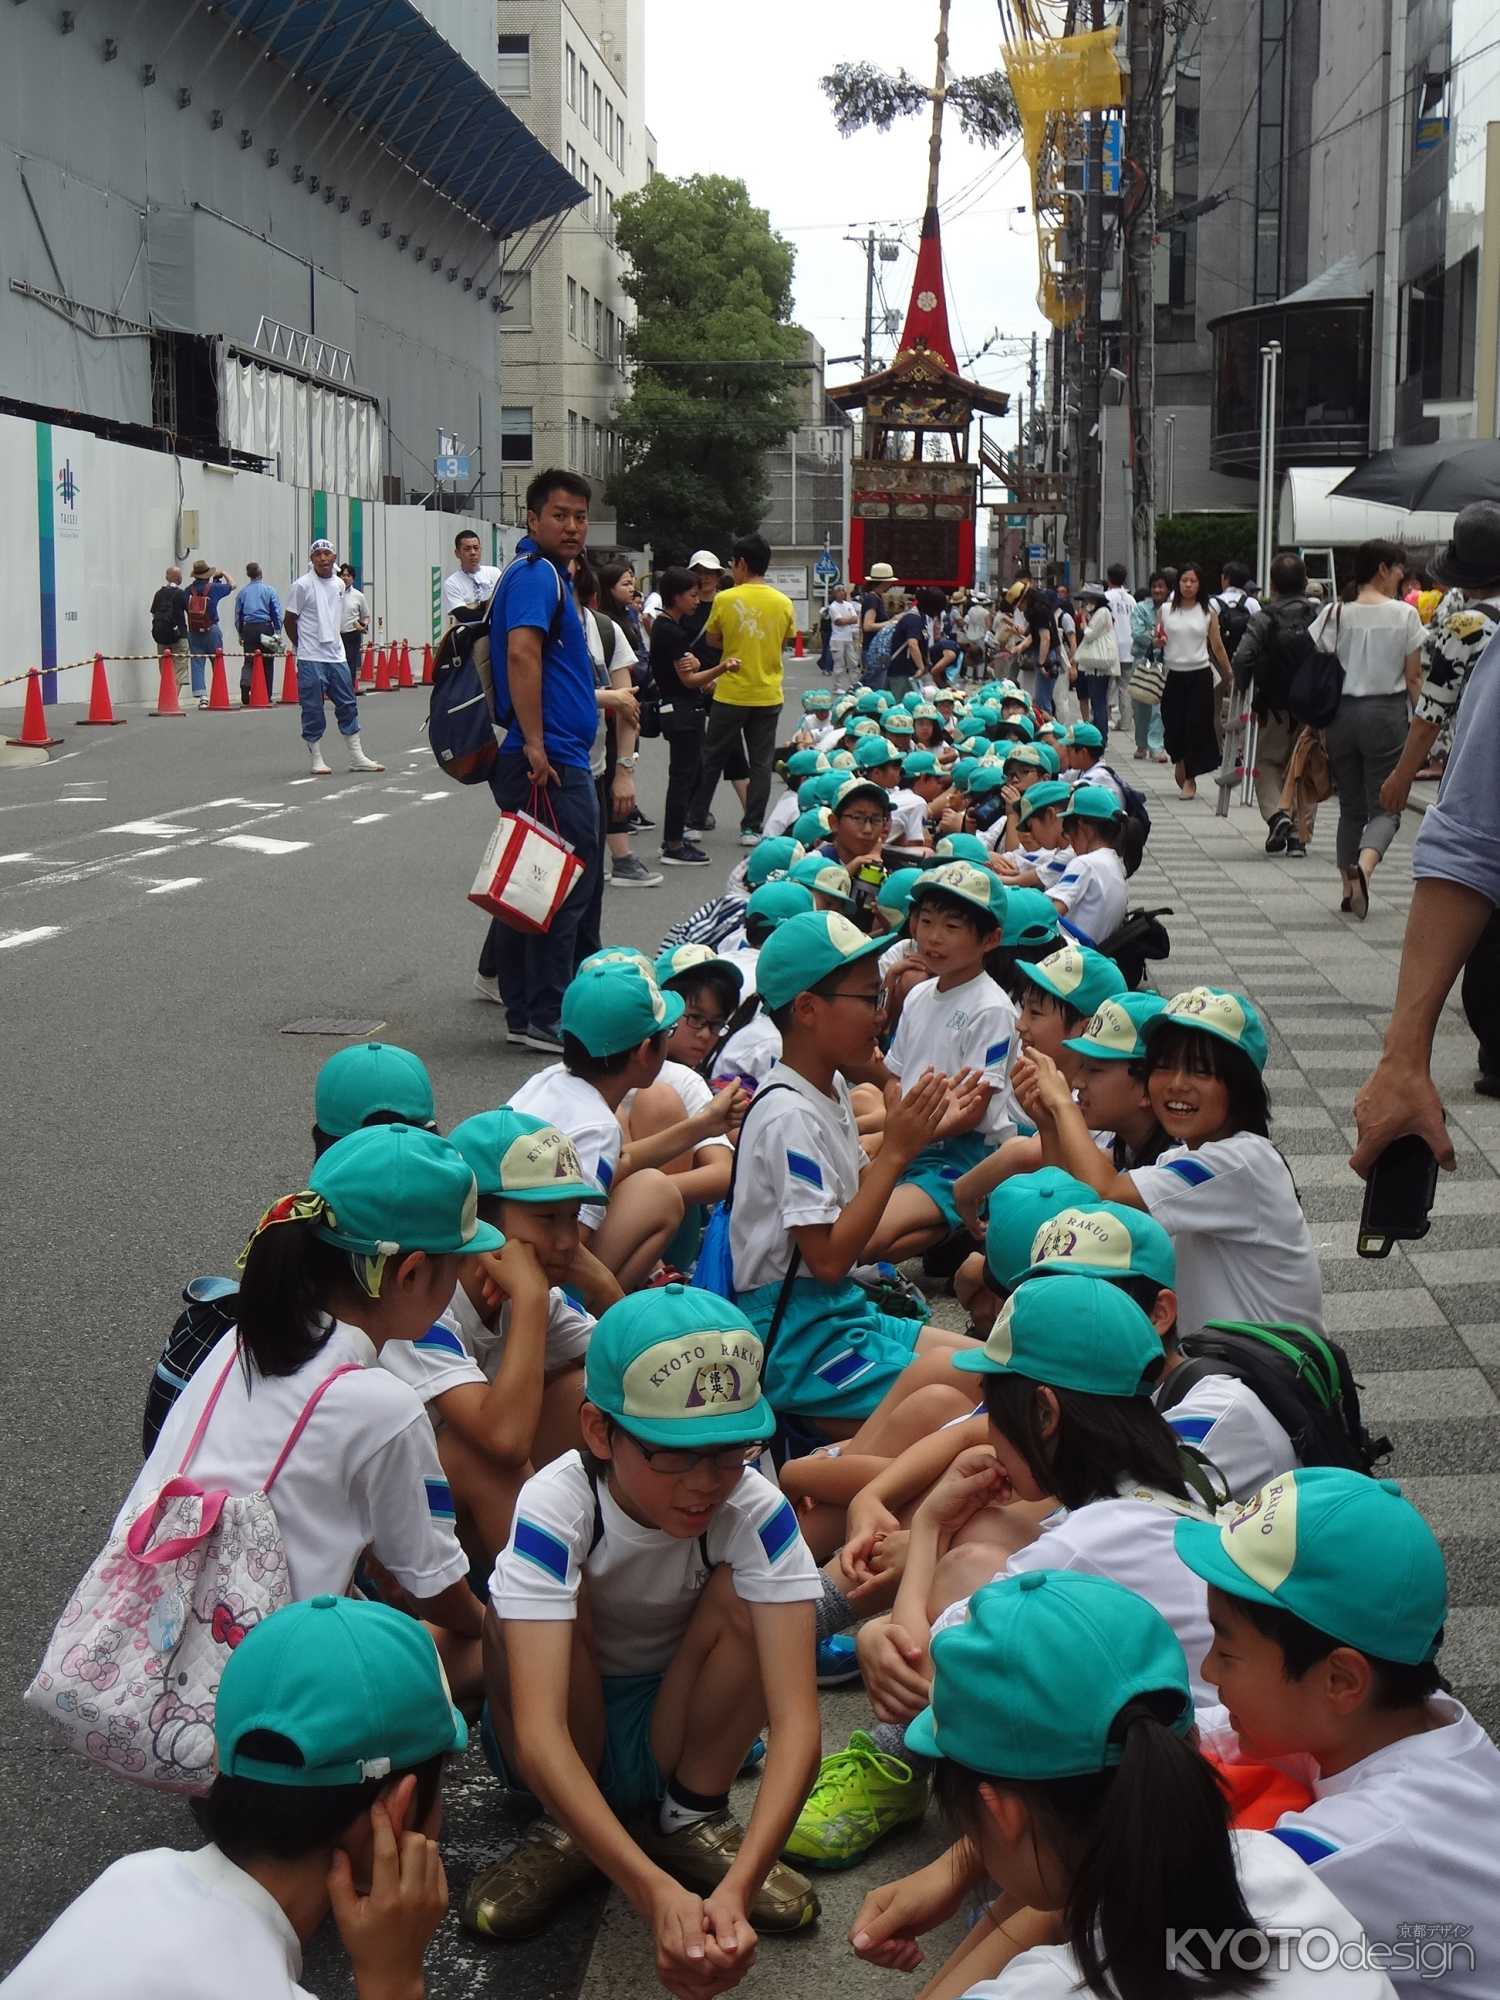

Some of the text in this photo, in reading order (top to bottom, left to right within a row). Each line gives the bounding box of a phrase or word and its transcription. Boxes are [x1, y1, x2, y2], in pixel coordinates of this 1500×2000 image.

[446, 458, 459, 478] 3
[1066, 1216, 1109, 1243] RAKUO
[649, 1343, 761, 1389] KYOTO RAKUO
